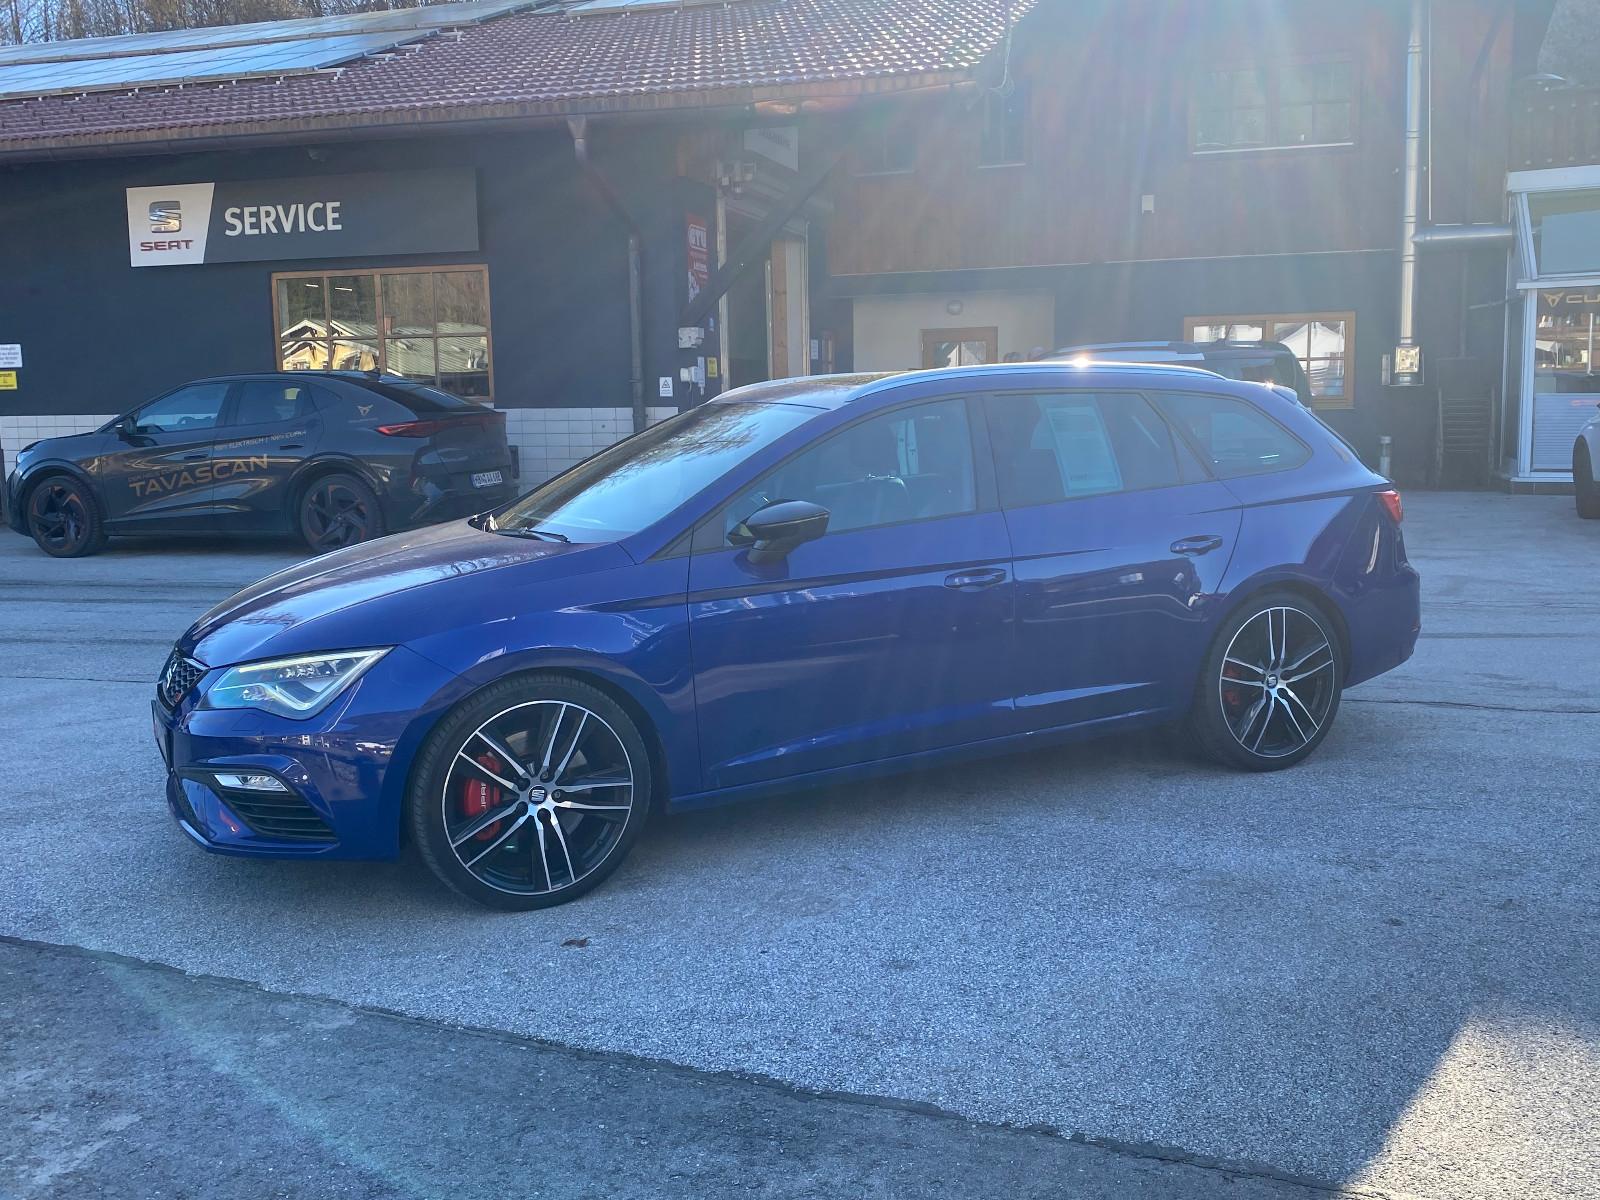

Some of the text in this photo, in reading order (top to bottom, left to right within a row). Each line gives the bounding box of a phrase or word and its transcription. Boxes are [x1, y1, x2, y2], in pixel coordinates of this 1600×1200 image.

[224, 201, 343, 237] SERVICE
[140, 239, 194, 252] SEAT
[129, 453, 269, 497] TAVASCAN
